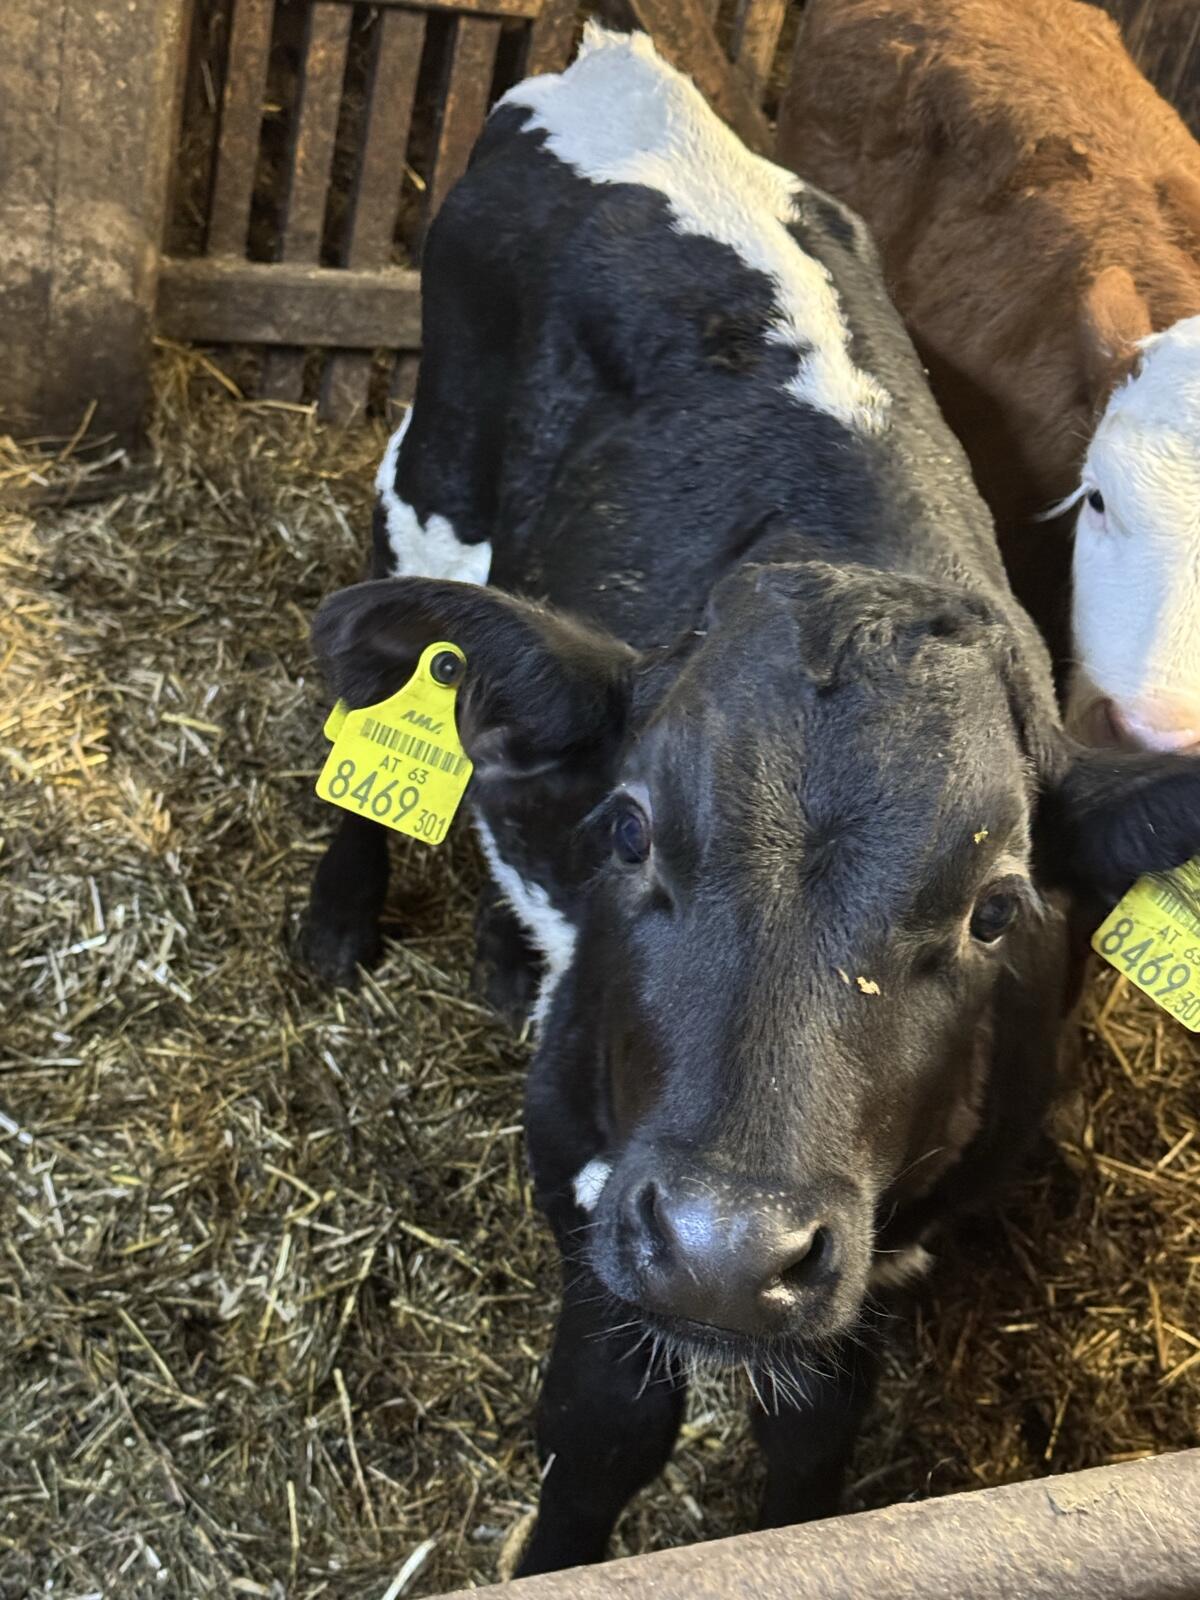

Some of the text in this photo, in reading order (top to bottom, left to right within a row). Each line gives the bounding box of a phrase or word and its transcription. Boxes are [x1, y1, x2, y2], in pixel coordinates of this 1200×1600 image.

[379, 755, 429, 785] AT 63
[328, 760, 447, 840] 8469 301
[1100, 918, 1191, 996] 8469
[1156, 925, 1182, 944] AT
